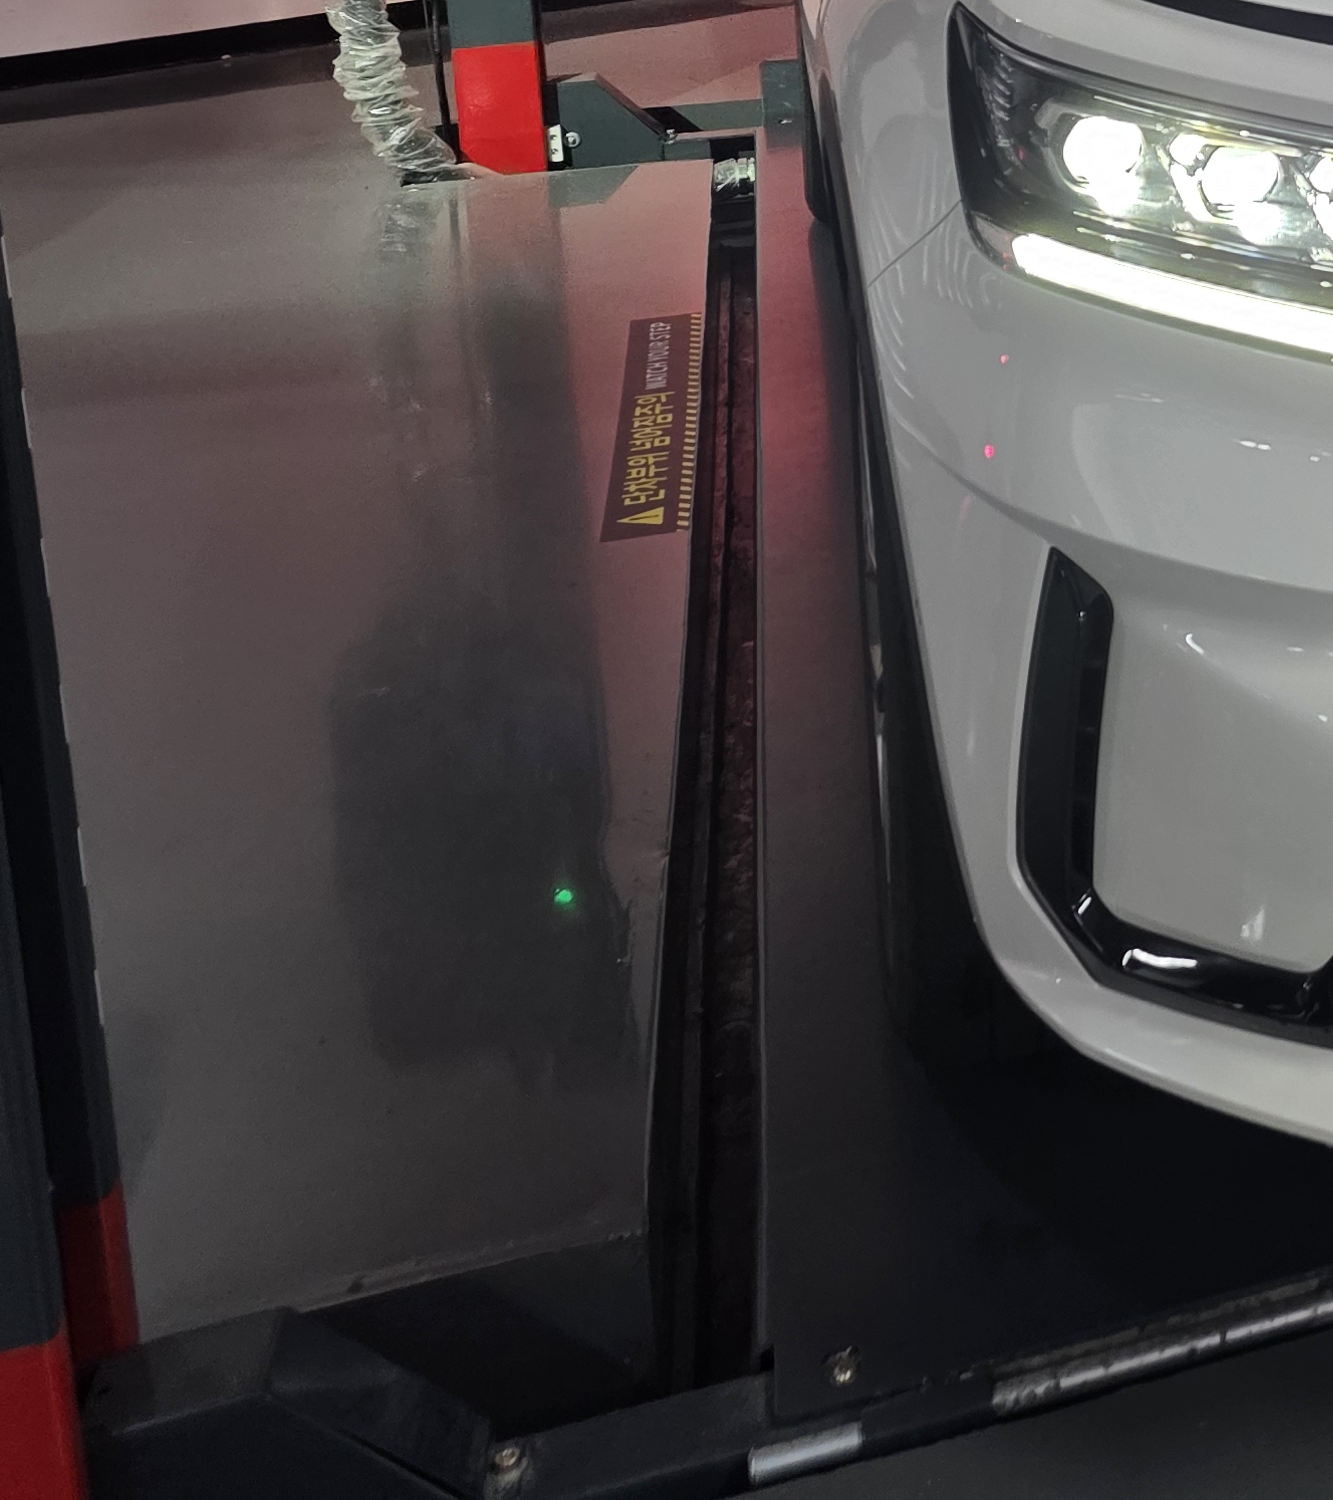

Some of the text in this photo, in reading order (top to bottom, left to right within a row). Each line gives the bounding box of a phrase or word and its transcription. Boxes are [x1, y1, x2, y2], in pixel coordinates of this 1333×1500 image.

[649, 321, 673, 341] STEP
[645, 362, 668, 391] WATCH
[620, 390, 676, 507] 단차부위 넘어짐주의
